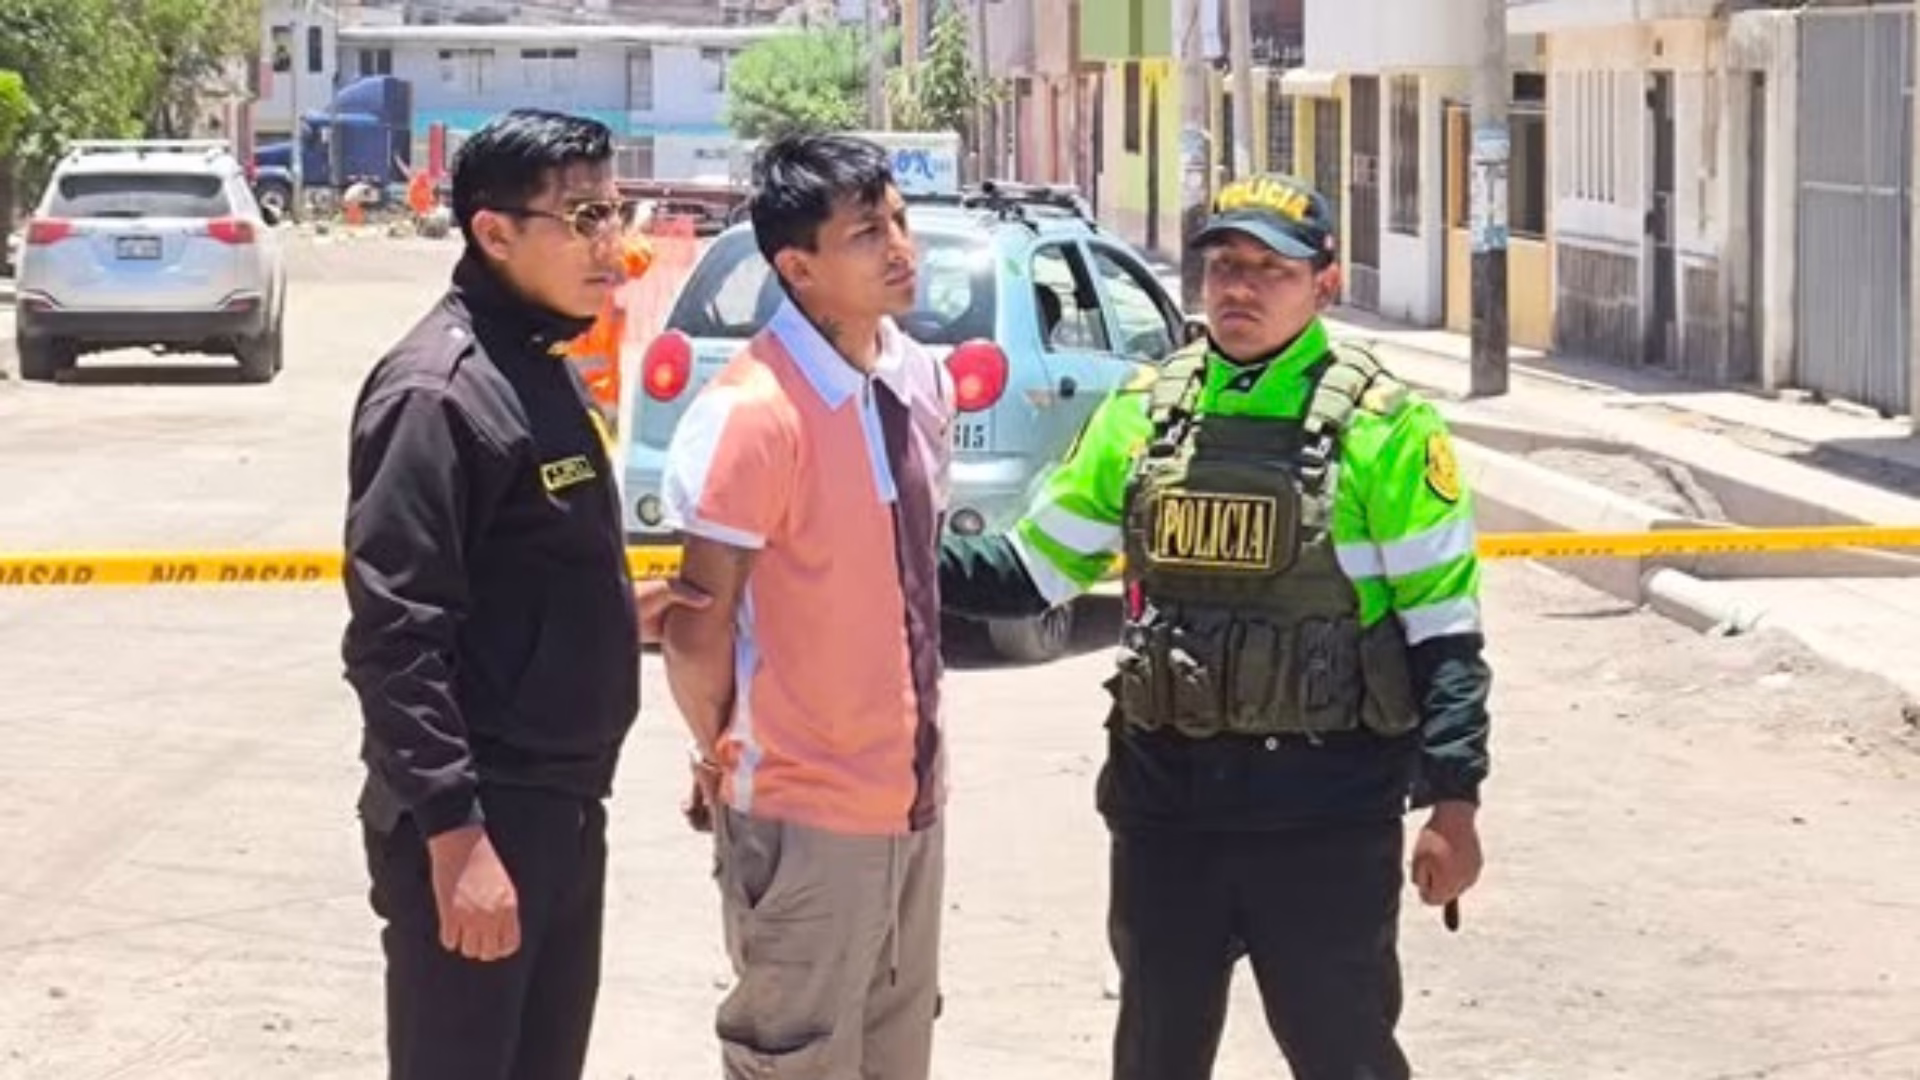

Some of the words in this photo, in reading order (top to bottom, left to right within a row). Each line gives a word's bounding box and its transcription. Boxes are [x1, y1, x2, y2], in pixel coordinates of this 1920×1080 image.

[1219, 178, 1304, 222] POLICIA
[1160, 497, 1264, 560] POLICIA
[0, 564, 94, 586] ASAR
